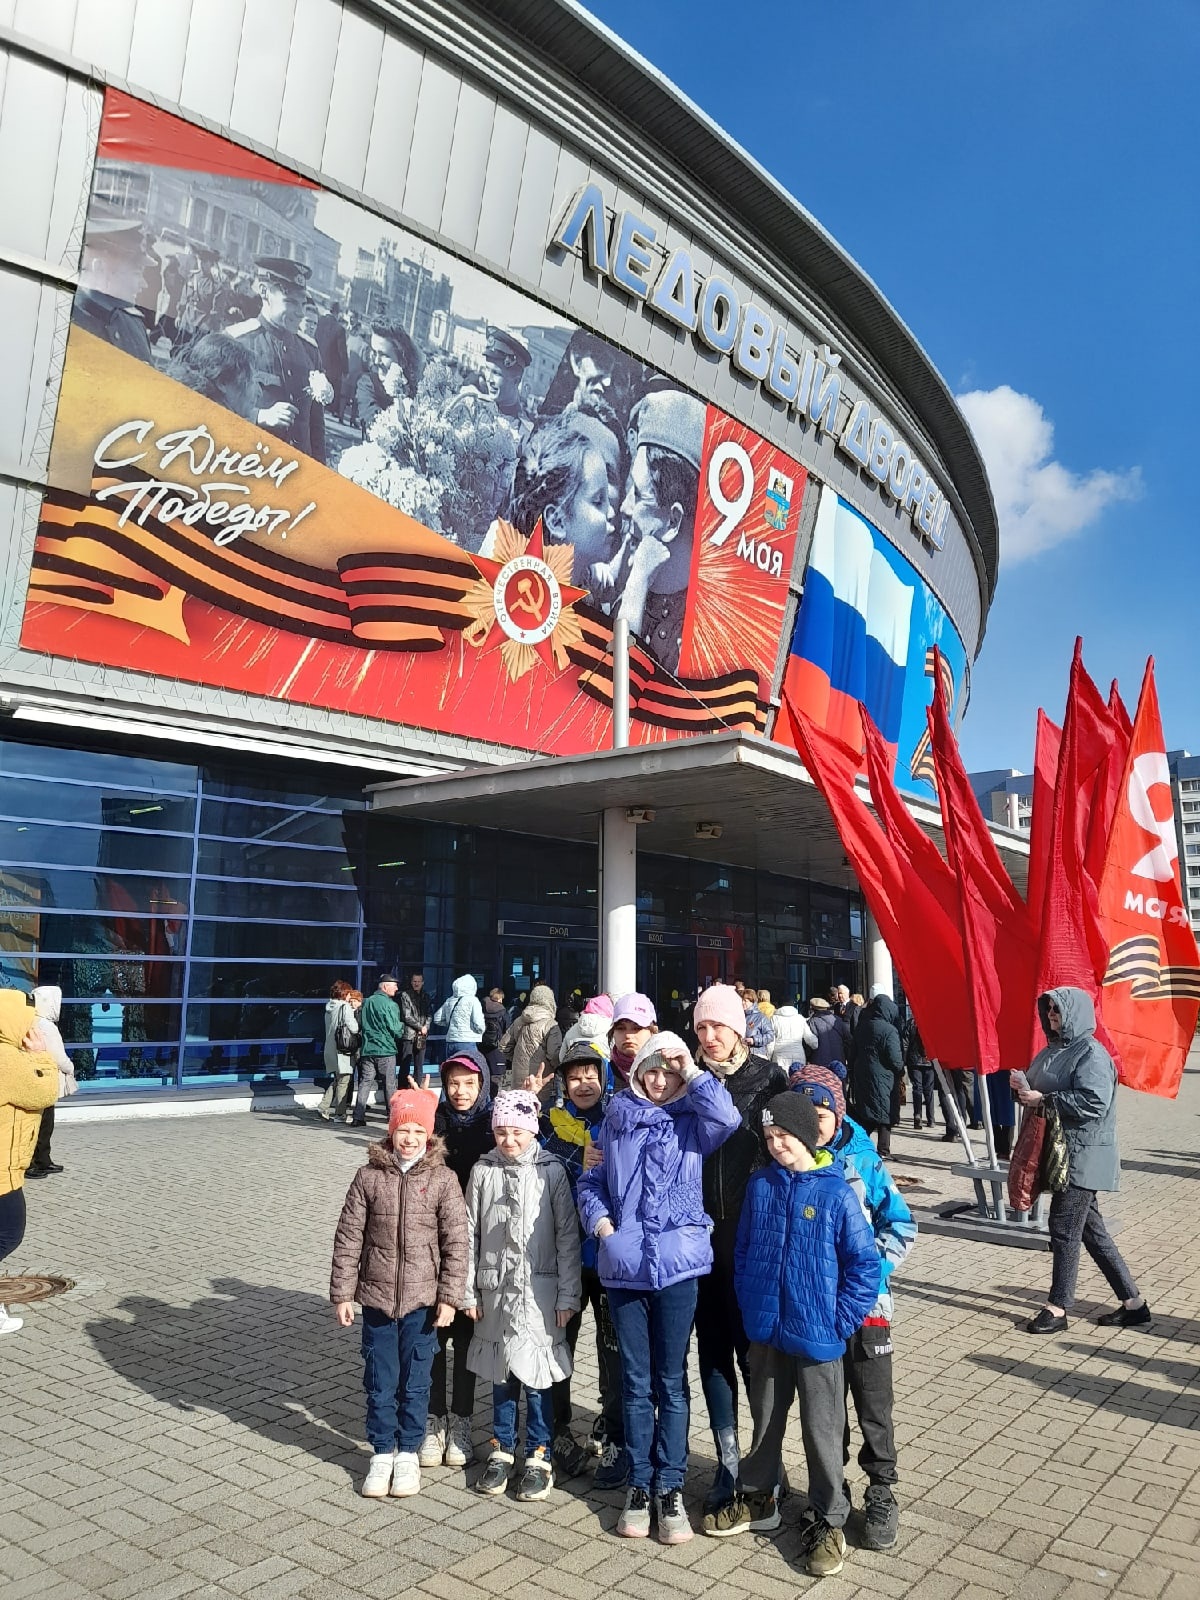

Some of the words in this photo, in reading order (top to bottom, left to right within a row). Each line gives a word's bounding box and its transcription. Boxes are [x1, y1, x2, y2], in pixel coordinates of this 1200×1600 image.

[553, 183, 842, 437] ЛЕДОВЫЙ
[839, 400, 950, 551] ДВОРЕЦ
[94, 420, 154, 469] С
[156, 424, 299, 488] Днём
[708, 441, 754, 546] 9
[95, 478, 317, 546] Победы!
